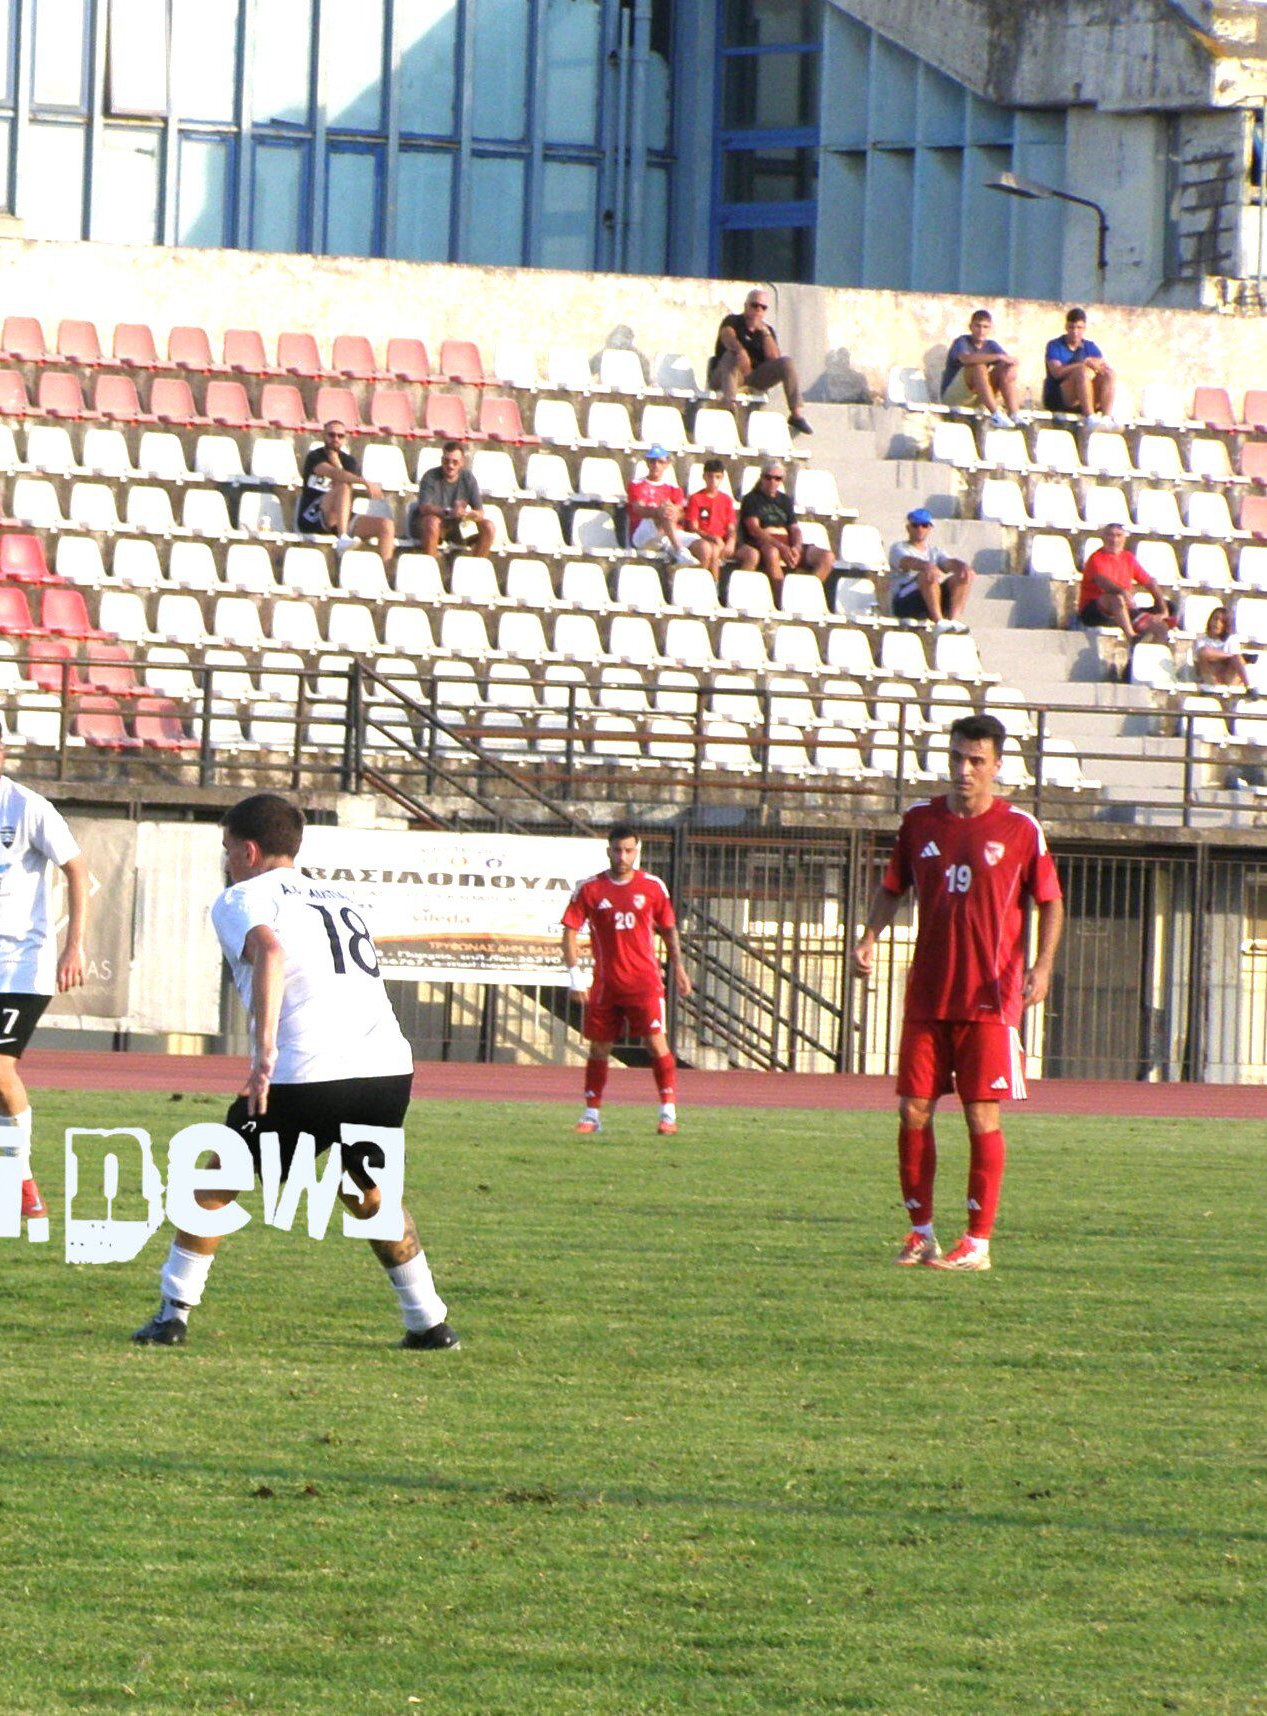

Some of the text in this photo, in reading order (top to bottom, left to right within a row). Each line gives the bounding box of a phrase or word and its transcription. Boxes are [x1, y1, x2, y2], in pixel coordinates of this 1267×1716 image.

[300, 866, 572, 891] ΒΑΣΙΛΟΠΟΥΛ
[945, 863, 972, 893] 19
[614, 911, 636, 930] 20
[305, 902, 381, 979] 18
[2, 1008, 20, 1034] 7
